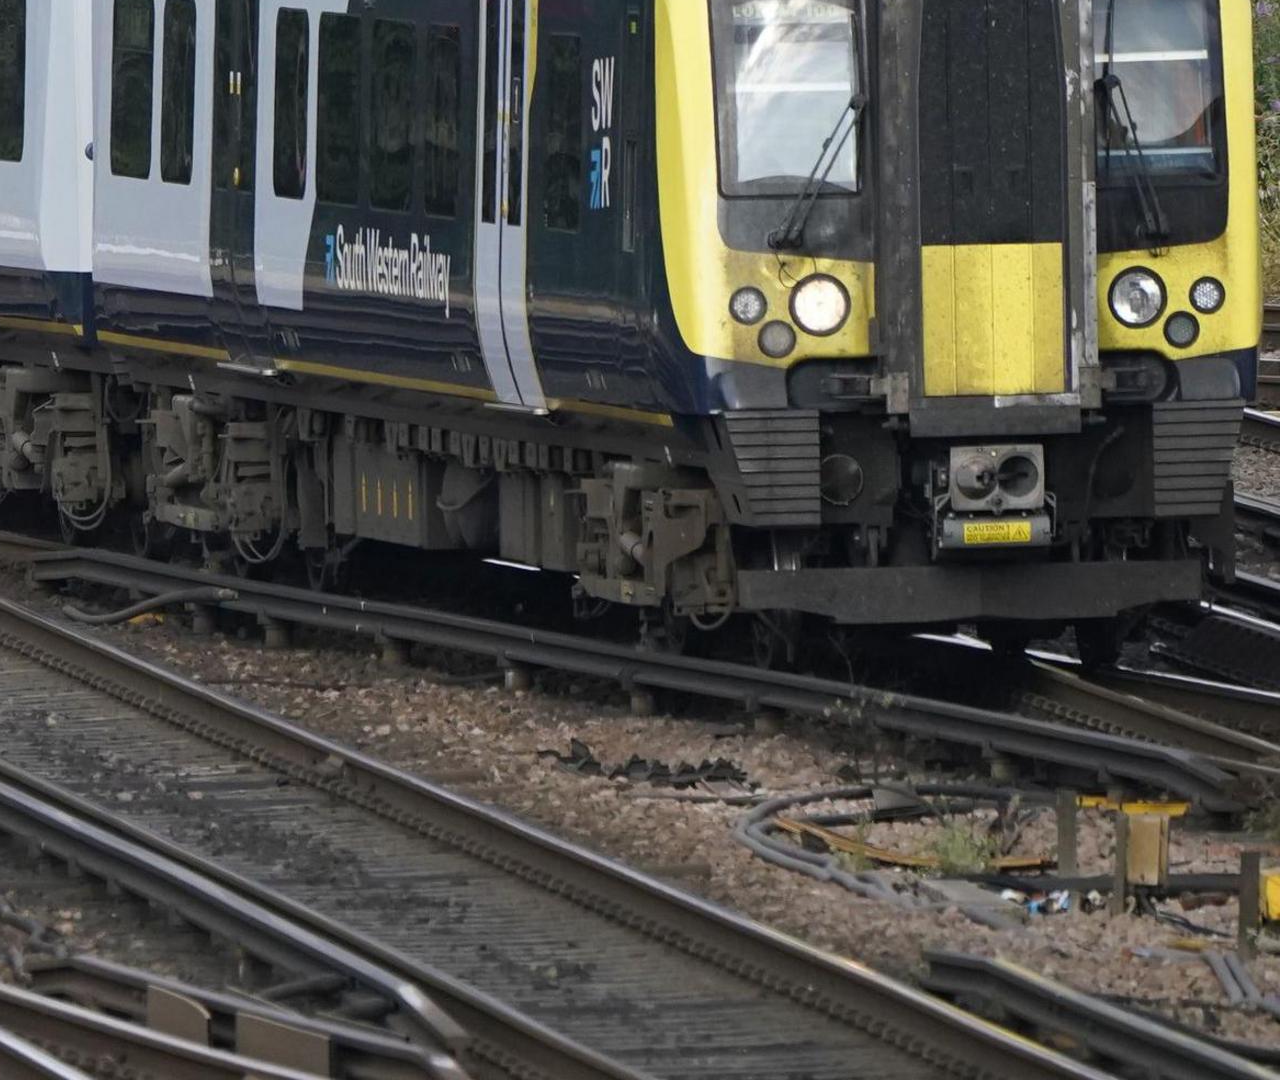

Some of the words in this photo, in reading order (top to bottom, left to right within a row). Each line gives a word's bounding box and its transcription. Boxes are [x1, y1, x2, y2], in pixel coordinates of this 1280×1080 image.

[591, 56, 615, 132] SW
[601, 136, 611, 209] R
[336, 223, 367, 291] South
[366, 227, 411, 297] Western
[410, 232, 451, 319] Railway
